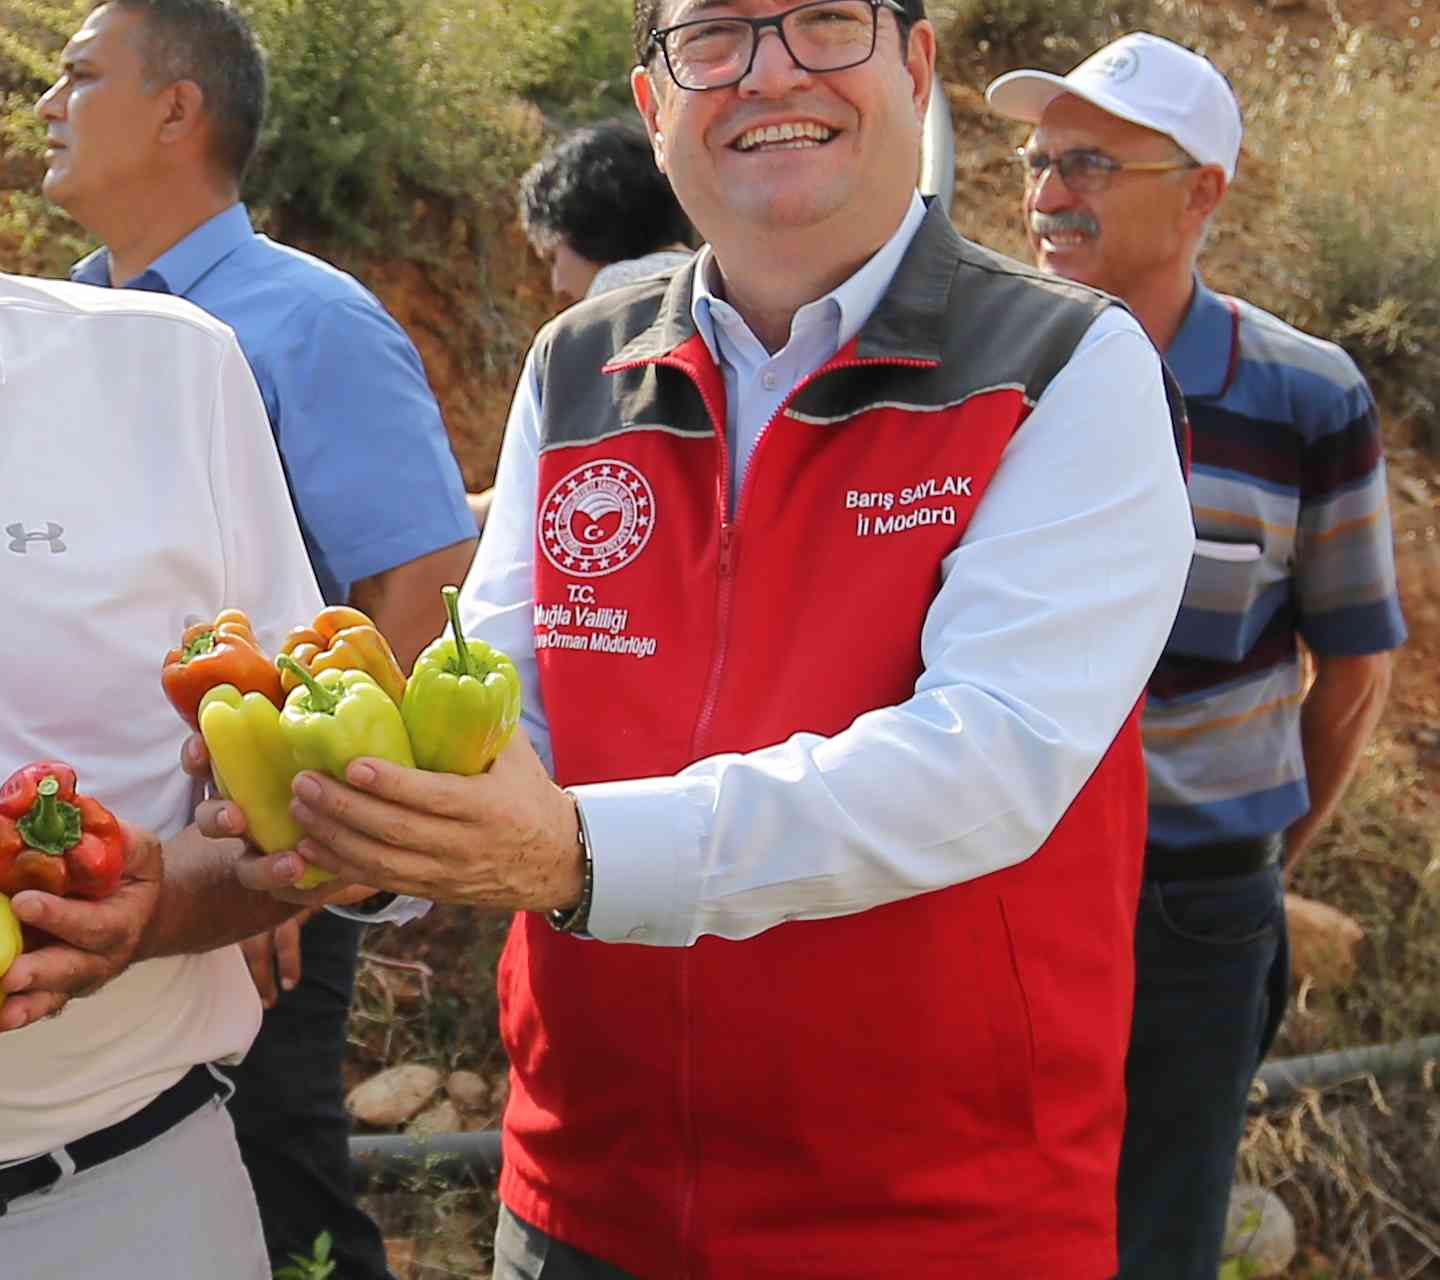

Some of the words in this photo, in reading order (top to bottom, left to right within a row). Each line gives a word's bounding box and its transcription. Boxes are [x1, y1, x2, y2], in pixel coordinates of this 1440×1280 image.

[845, 489, 895, 511] Barış
[898, 475, 973, 506] SAYLAK
[566, 583, 596, 605] T.C.
[574, 605, 628, 635] Valiliği
[548, 630, 589, 651] Orman
